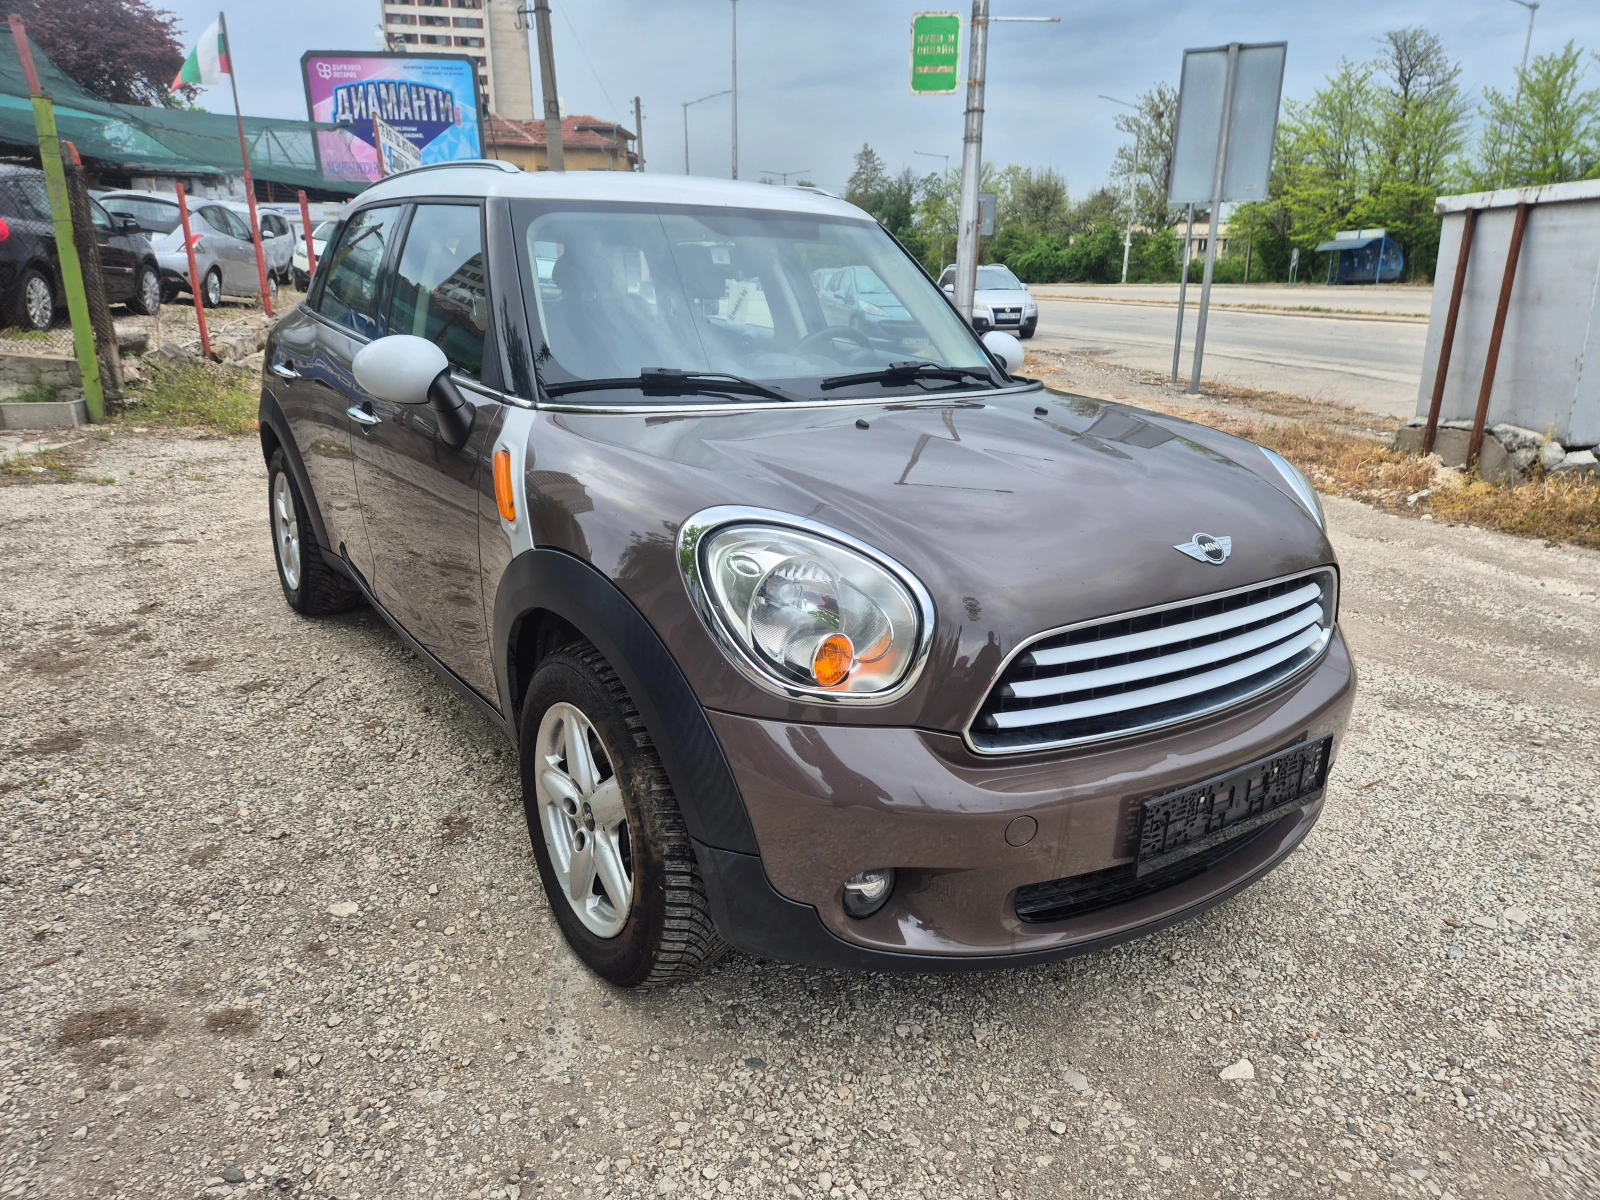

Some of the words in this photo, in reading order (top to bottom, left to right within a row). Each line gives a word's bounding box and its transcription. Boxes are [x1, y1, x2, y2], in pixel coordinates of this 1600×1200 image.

[918, 34, 943, 43] КУПИ
[948, 34, 955, 43] И
[917, 44, 954, 54] ОНЛАЙН
[335, 82, 453, 123] ДИАМАНТИ
[1200, 542, 1221, 552] MINI
